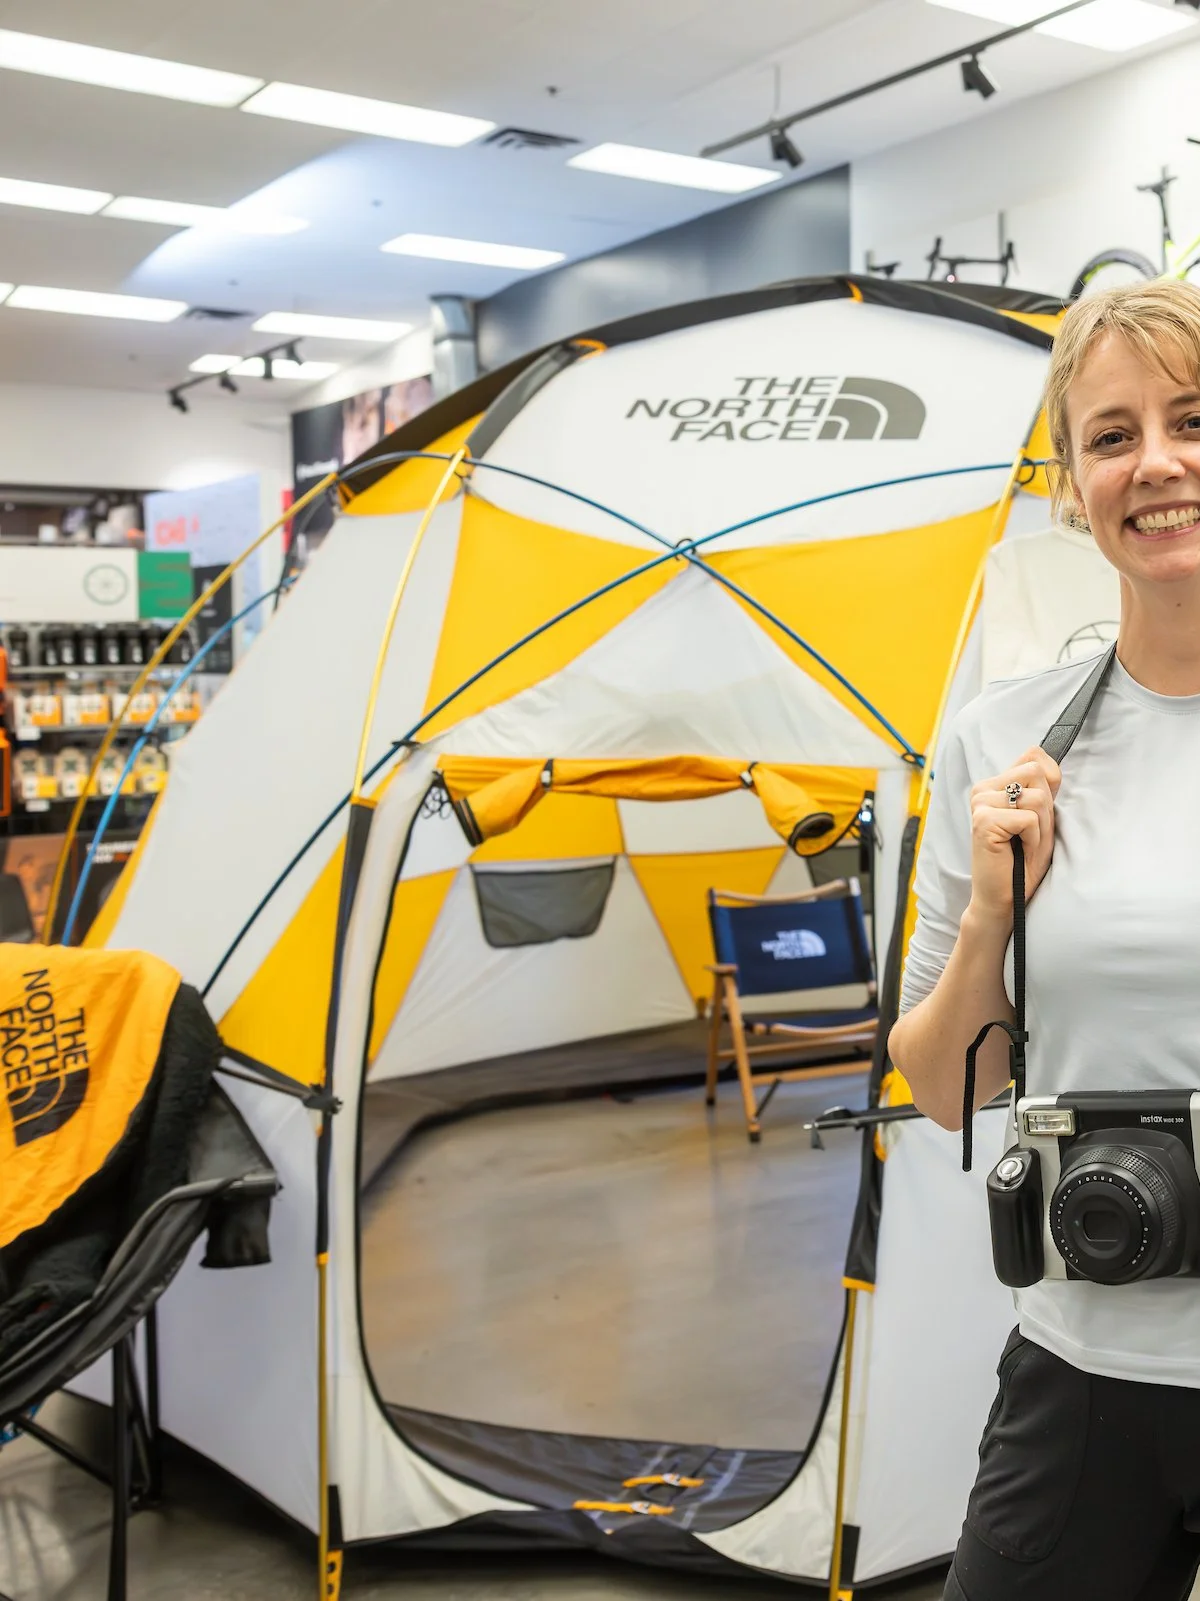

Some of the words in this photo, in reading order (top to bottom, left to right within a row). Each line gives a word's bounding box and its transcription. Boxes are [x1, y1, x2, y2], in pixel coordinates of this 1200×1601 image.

[734, 376, 838, 396] THE
[625, 398, 828, 419] NORTH
[670, 420, 818, 441] FACE
[22, 969, 59, 1078] NORTH
[0, 1006, 32, 1089] FACE
[59, 1007, 89, 1069] THE
[1140, 1115, 1163, 1123] instax
